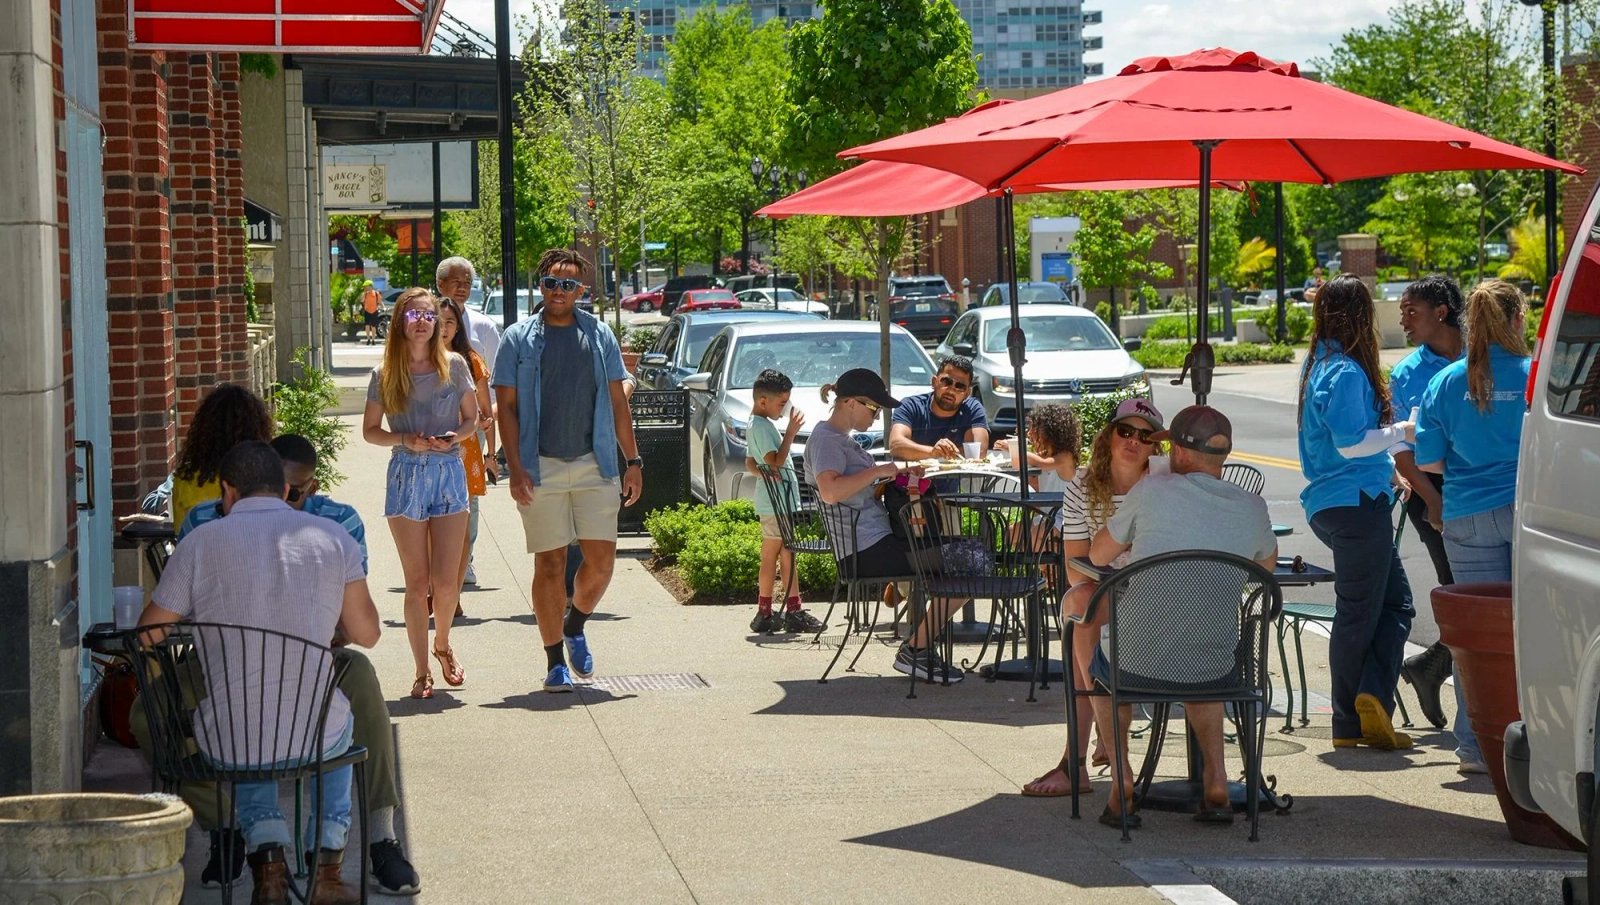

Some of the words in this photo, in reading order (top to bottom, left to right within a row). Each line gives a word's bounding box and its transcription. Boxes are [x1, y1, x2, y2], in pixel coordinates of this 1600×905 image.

[328, 172, 366, 183] NANCY'S
[333, 183, 361, 191] BAGEL
[338, 190, 356, 198] BOX
